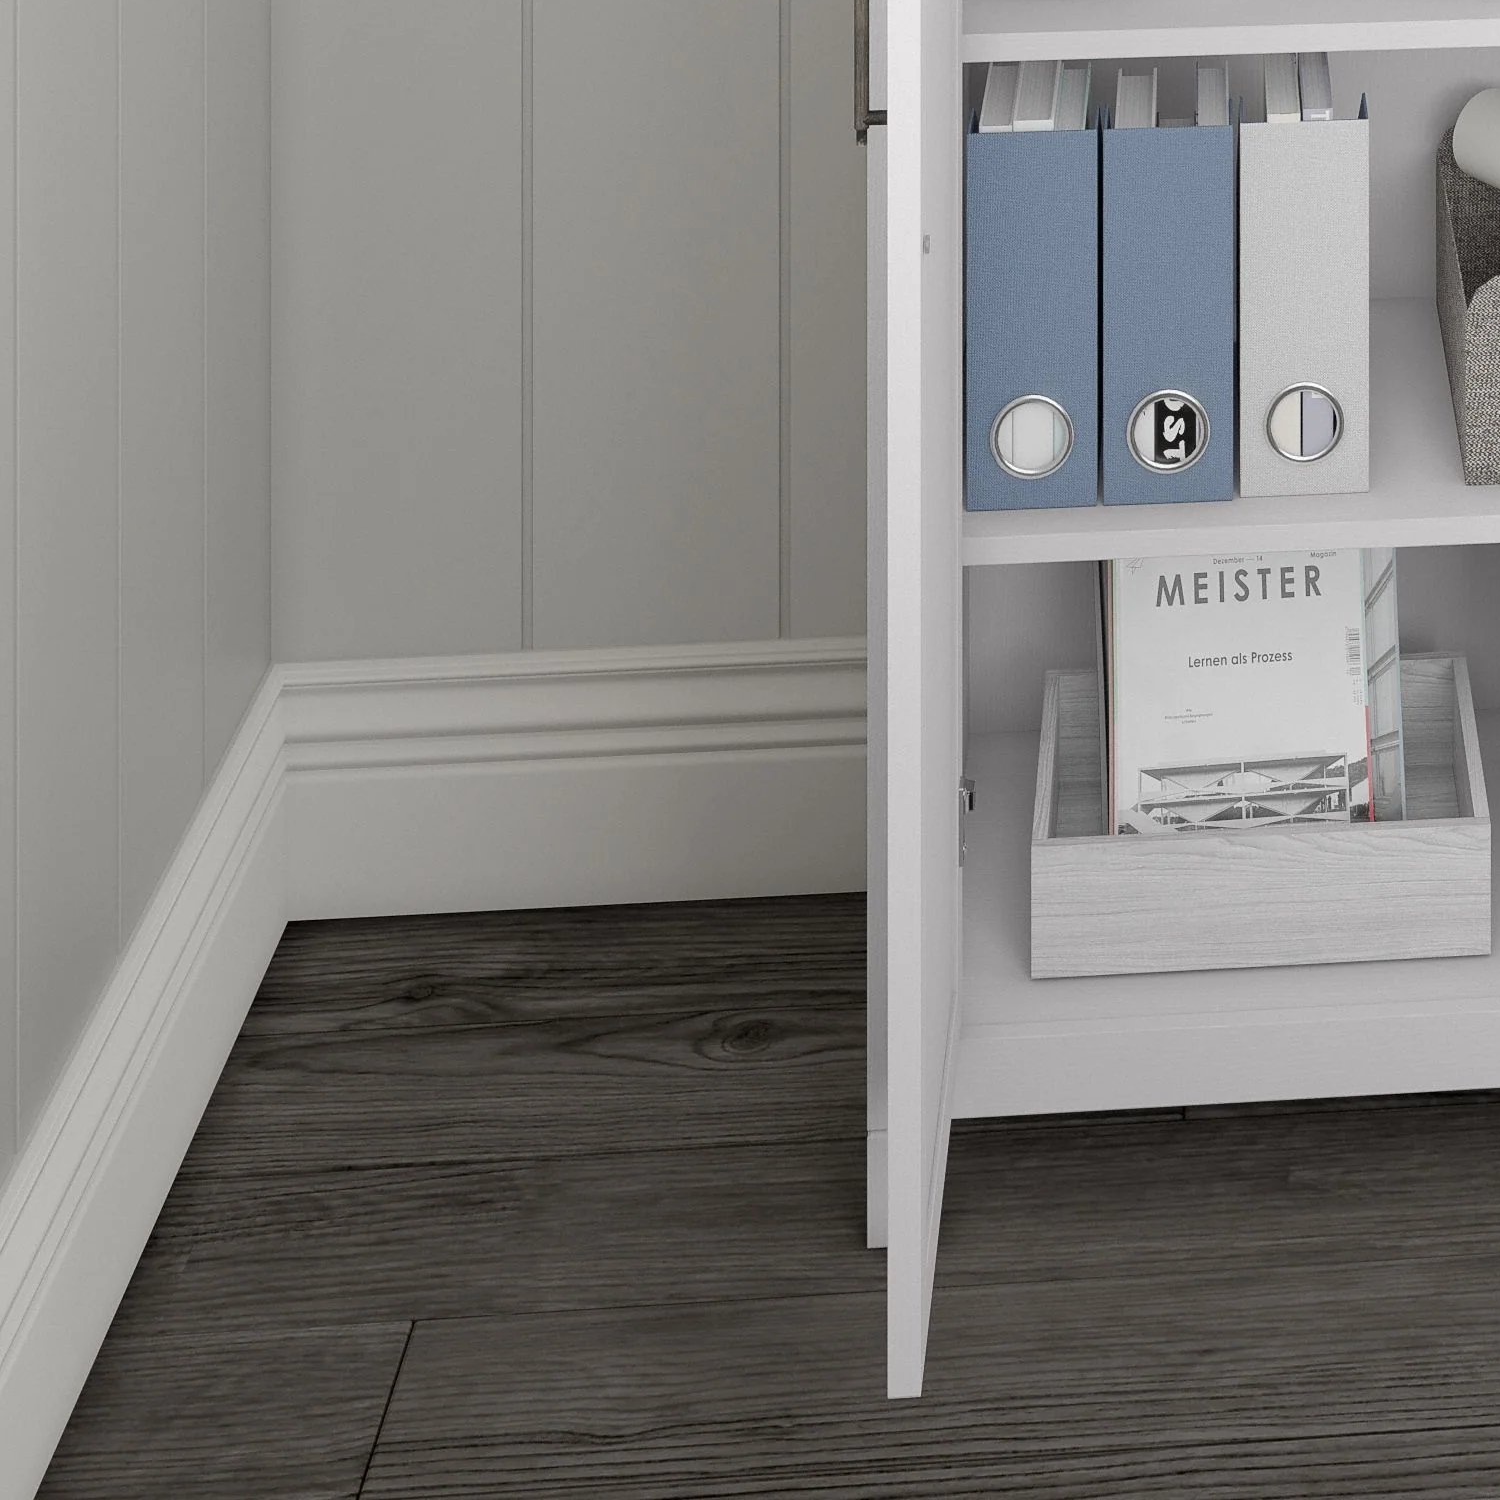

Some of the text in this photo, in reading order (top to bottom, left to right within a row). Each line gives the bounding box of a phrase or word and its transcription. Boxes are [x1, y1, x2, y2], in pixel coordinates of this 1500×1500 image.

[1310, 550, 1337, 558] Magazin
[1213, 557, 1245, 565] Dezember
[1156, 565, 1321, 607] MEISTER
[1188, 651, 1293, 668] Lernen als Prozess
